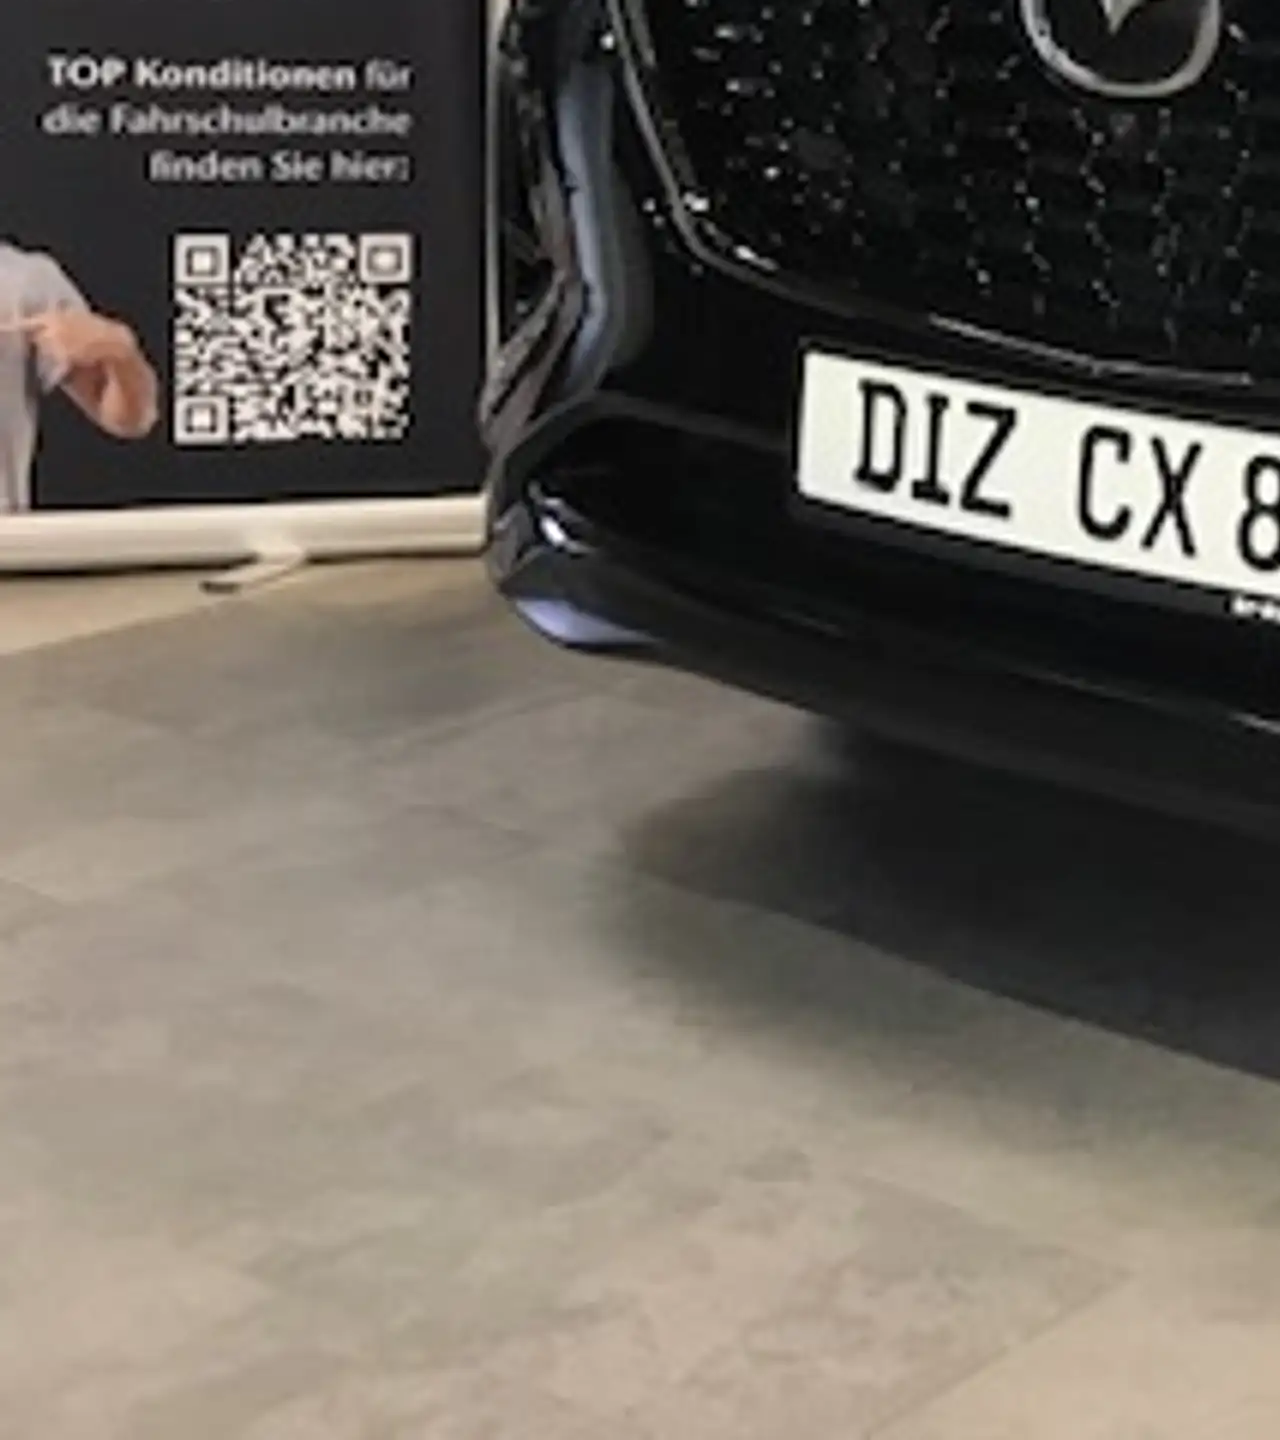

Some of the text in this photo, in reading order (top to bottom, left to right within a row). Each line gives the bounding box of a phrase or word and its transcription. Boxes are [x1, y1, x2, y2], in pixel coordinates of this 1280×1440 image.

[47, 58, 412, 90] TOP Konditionen für
[42, 103, 412, 135] die Fahrschulbranche
[149, 151, 263, 181] finden
[271, 151, 324, 181] Sie
[856, 379, 1018, 518] DIZ
[1078, 426, 1204, 557] CX
